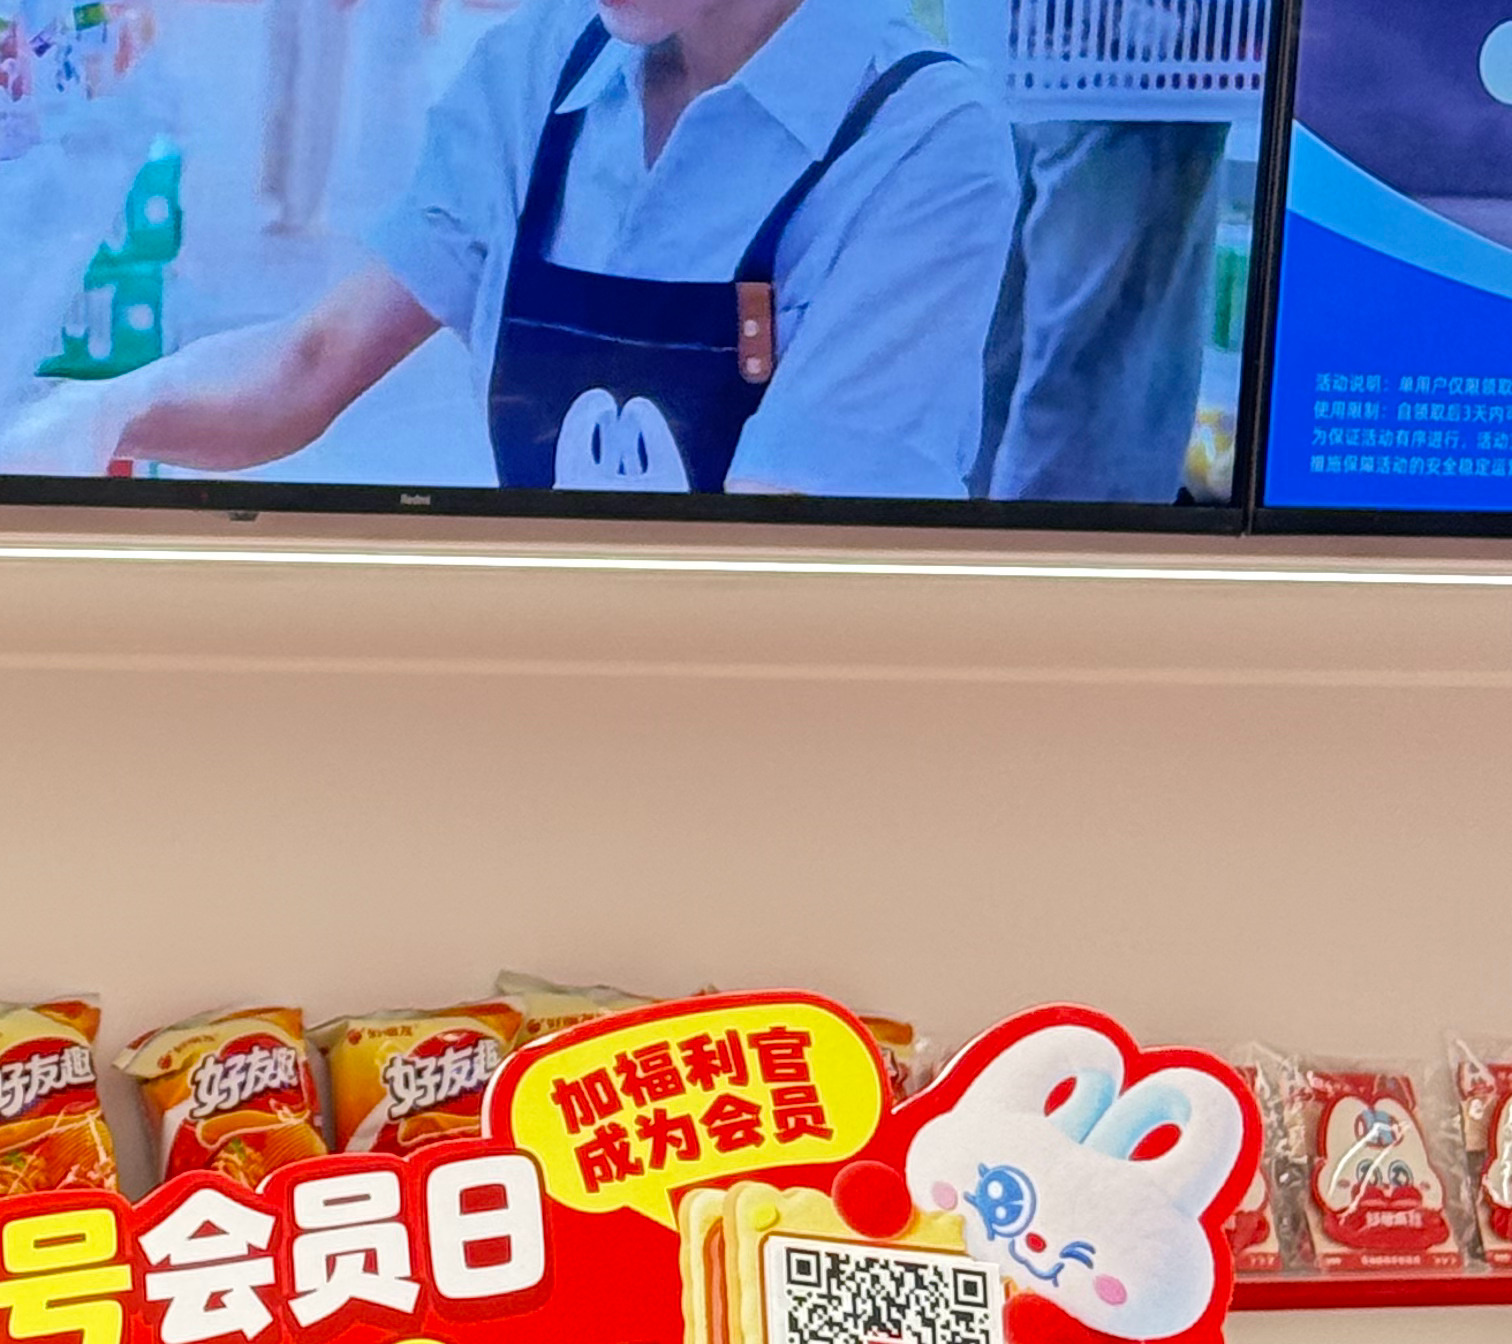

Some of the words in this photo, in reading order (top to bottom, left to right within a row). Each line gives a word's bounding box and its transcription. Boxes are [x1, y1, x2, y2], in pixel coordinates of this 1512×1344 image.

[191, 1045, 299, 1119] 好友趣
[551, 1025, 814, 1135] 加福利官
[574, 1083, 833, 1193] 成为会员
